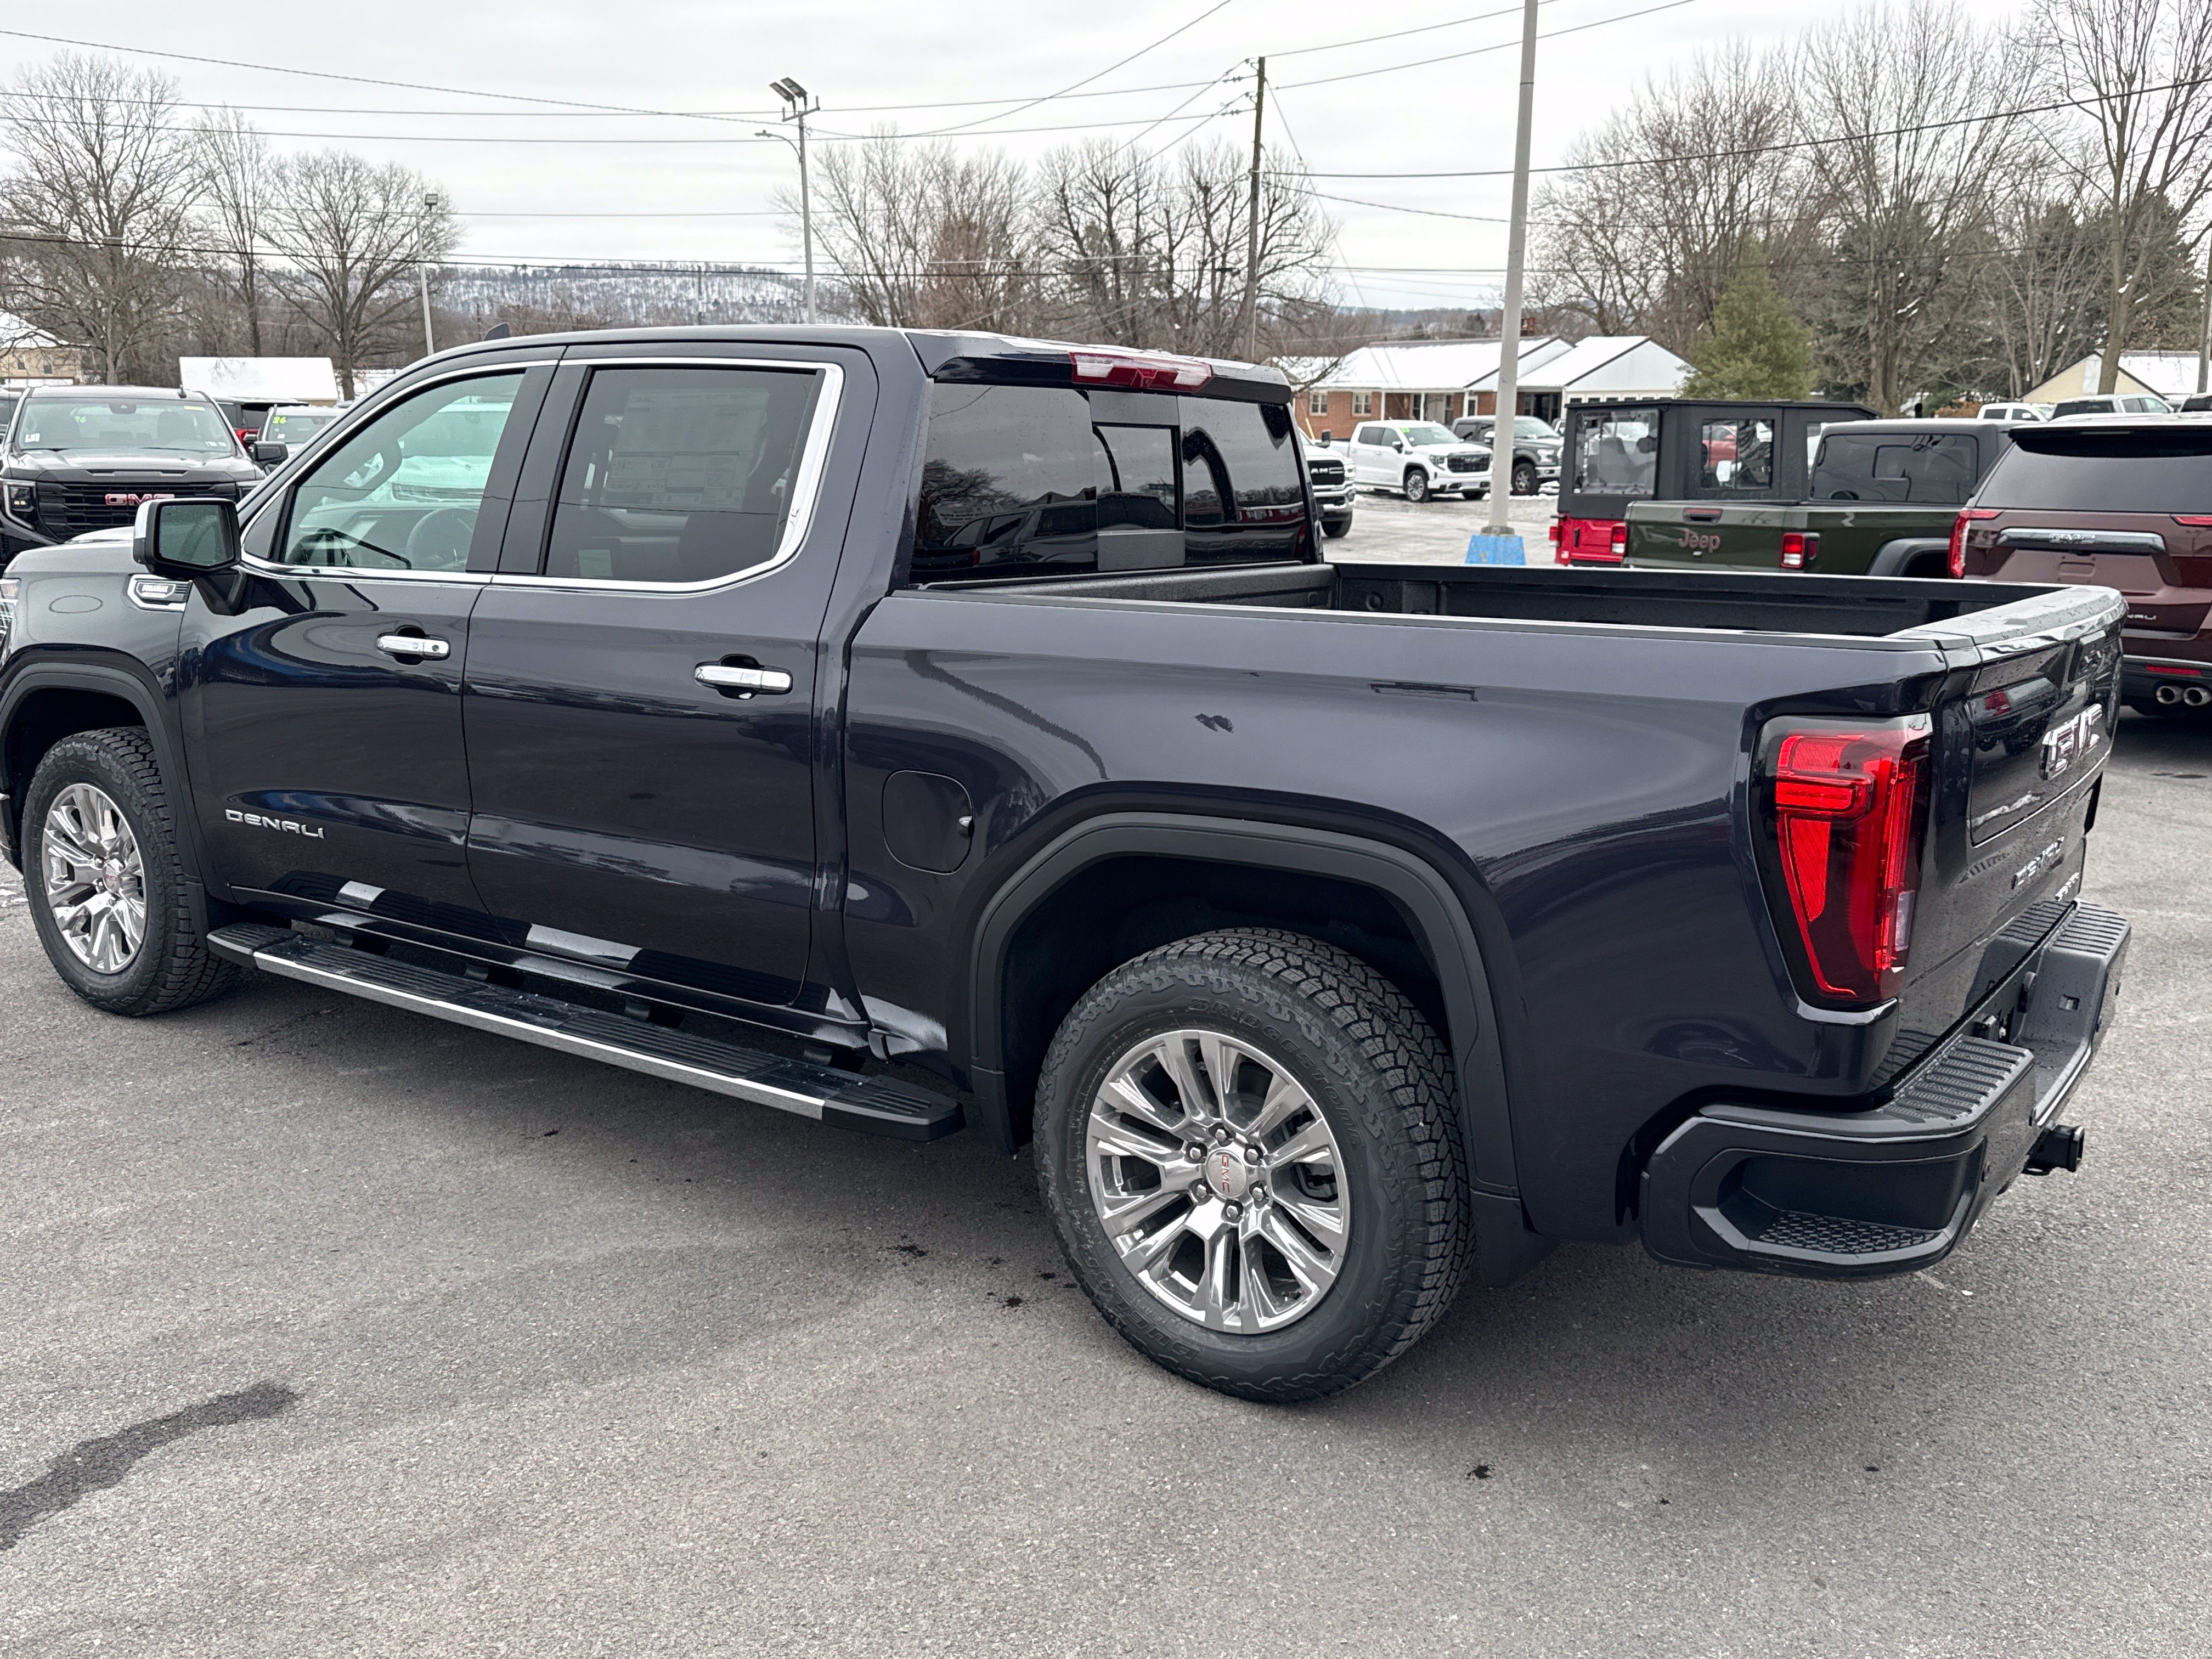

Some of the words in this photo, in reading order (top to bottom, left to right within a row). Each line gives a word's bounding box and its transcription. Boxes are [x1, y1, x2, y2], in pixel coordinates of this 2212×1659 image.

[1678, 528, 1721, 554] Jeep
[2049, 533, 2095, 544] GMC
[225, 809, 325, 839] DENALI
[1187, 996, 1365, 1150] BRIDGESTONE
[1221, 1155, 1230, 1193] GMC
